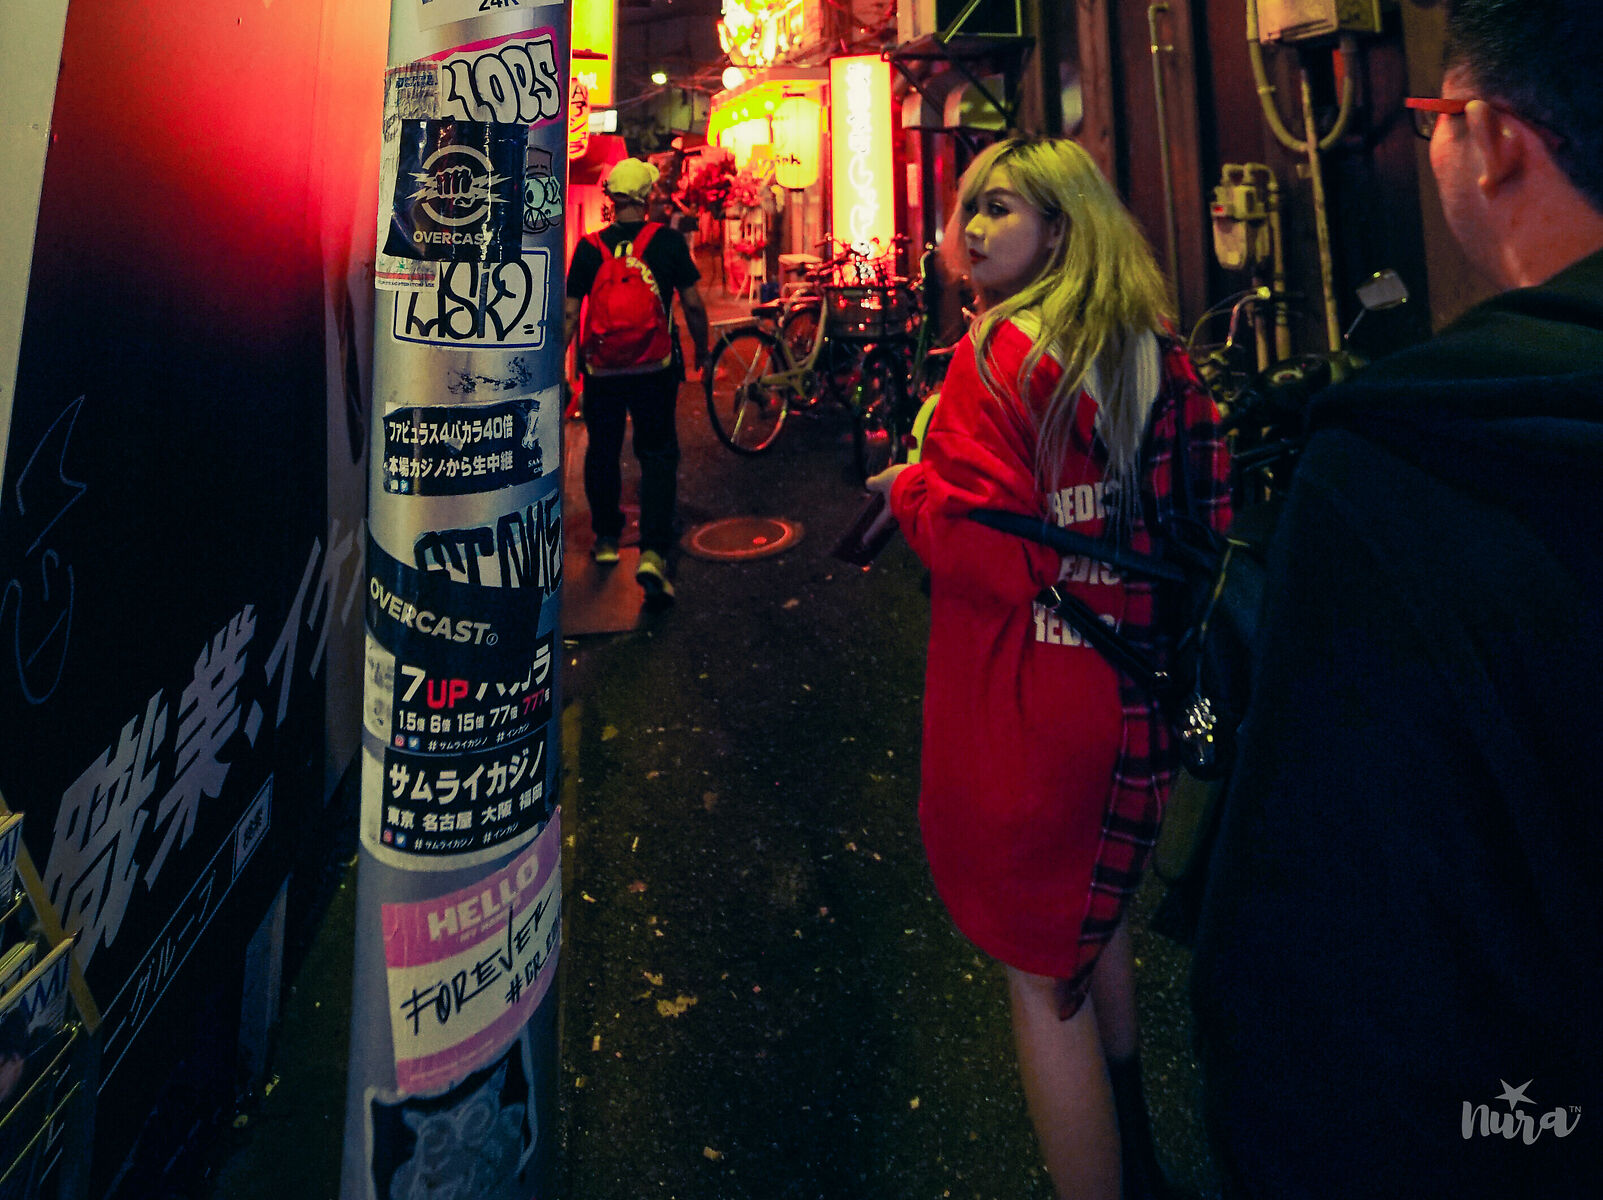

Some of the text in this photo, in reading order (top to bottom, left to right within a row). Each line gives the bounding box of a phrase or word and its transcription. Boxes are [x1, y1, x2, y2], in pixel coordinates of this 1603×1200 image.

[412, 230, 493, 246] OVERCAS
[370, 576, 491, 645] OVERCAST
[389, 740, 544, 805] サムライカジノ
[387, 781, 543, 832] 東京 名古屋 大阪 福岡
[427, 853, 539, 942] HELLO
